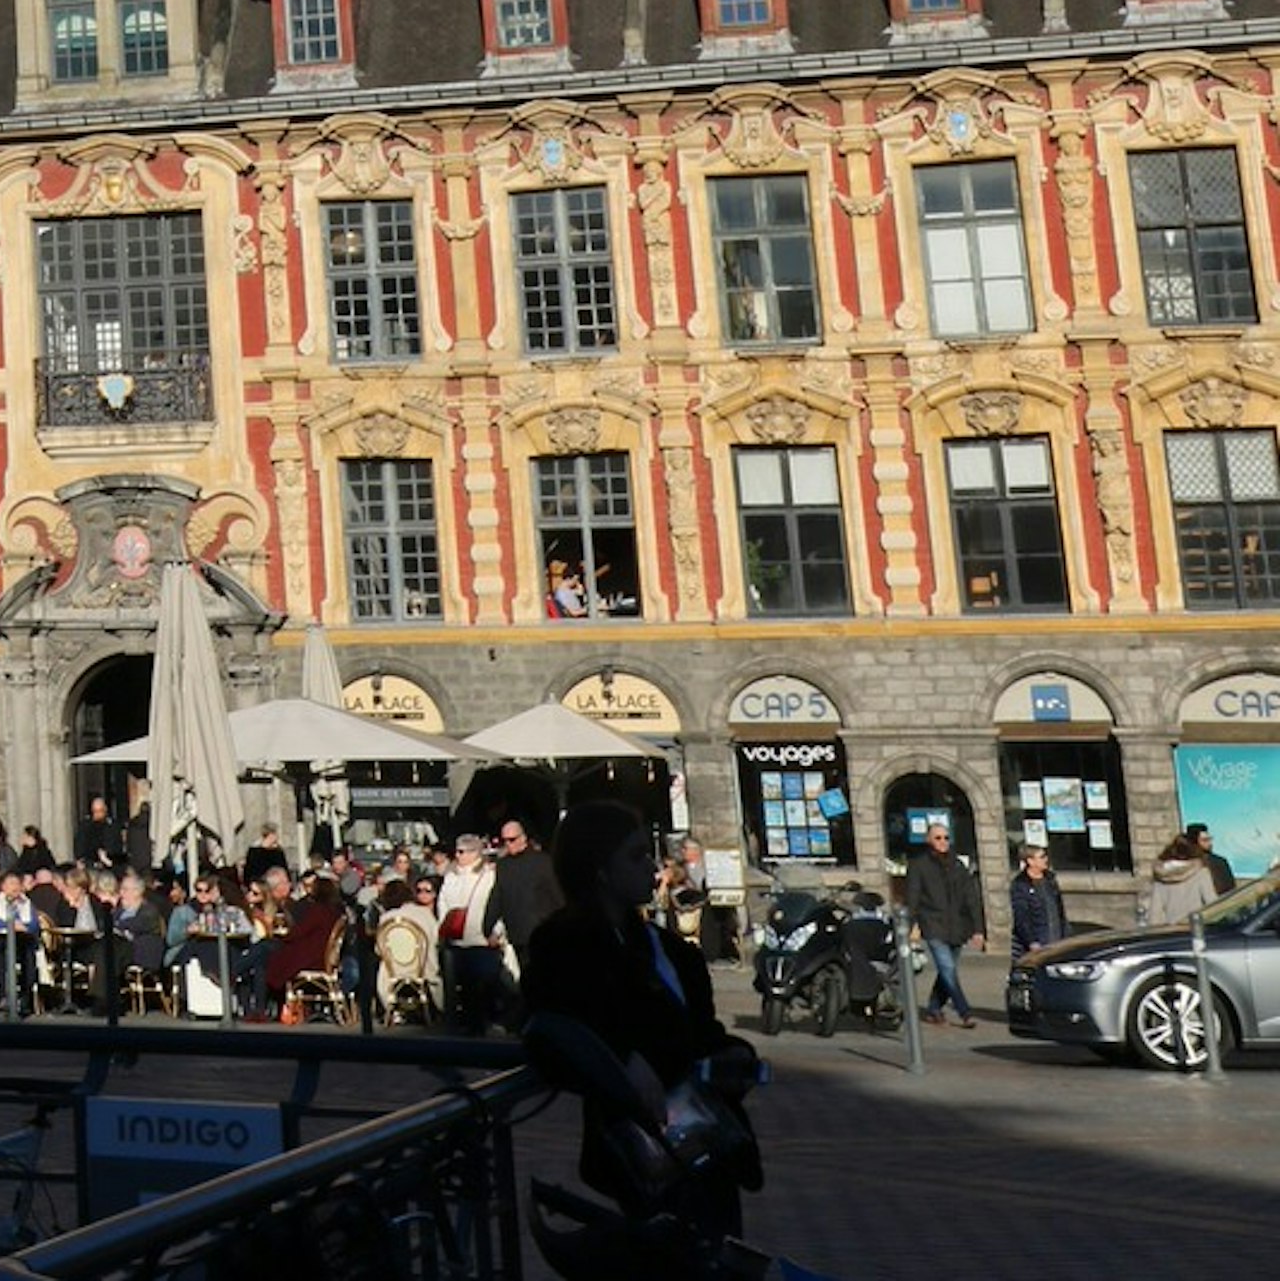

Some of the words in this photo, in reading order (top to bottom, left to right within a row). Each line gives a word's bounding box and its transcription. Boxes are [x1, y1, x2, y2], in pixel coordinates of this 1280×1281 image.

[344, 697, 364, 710] LA
[576, 695, 597, 708] LA
[740, 693, 802, 718] CAP
[809, 693, 827, 718] 5
[743, 745, 835, 766] voyages
